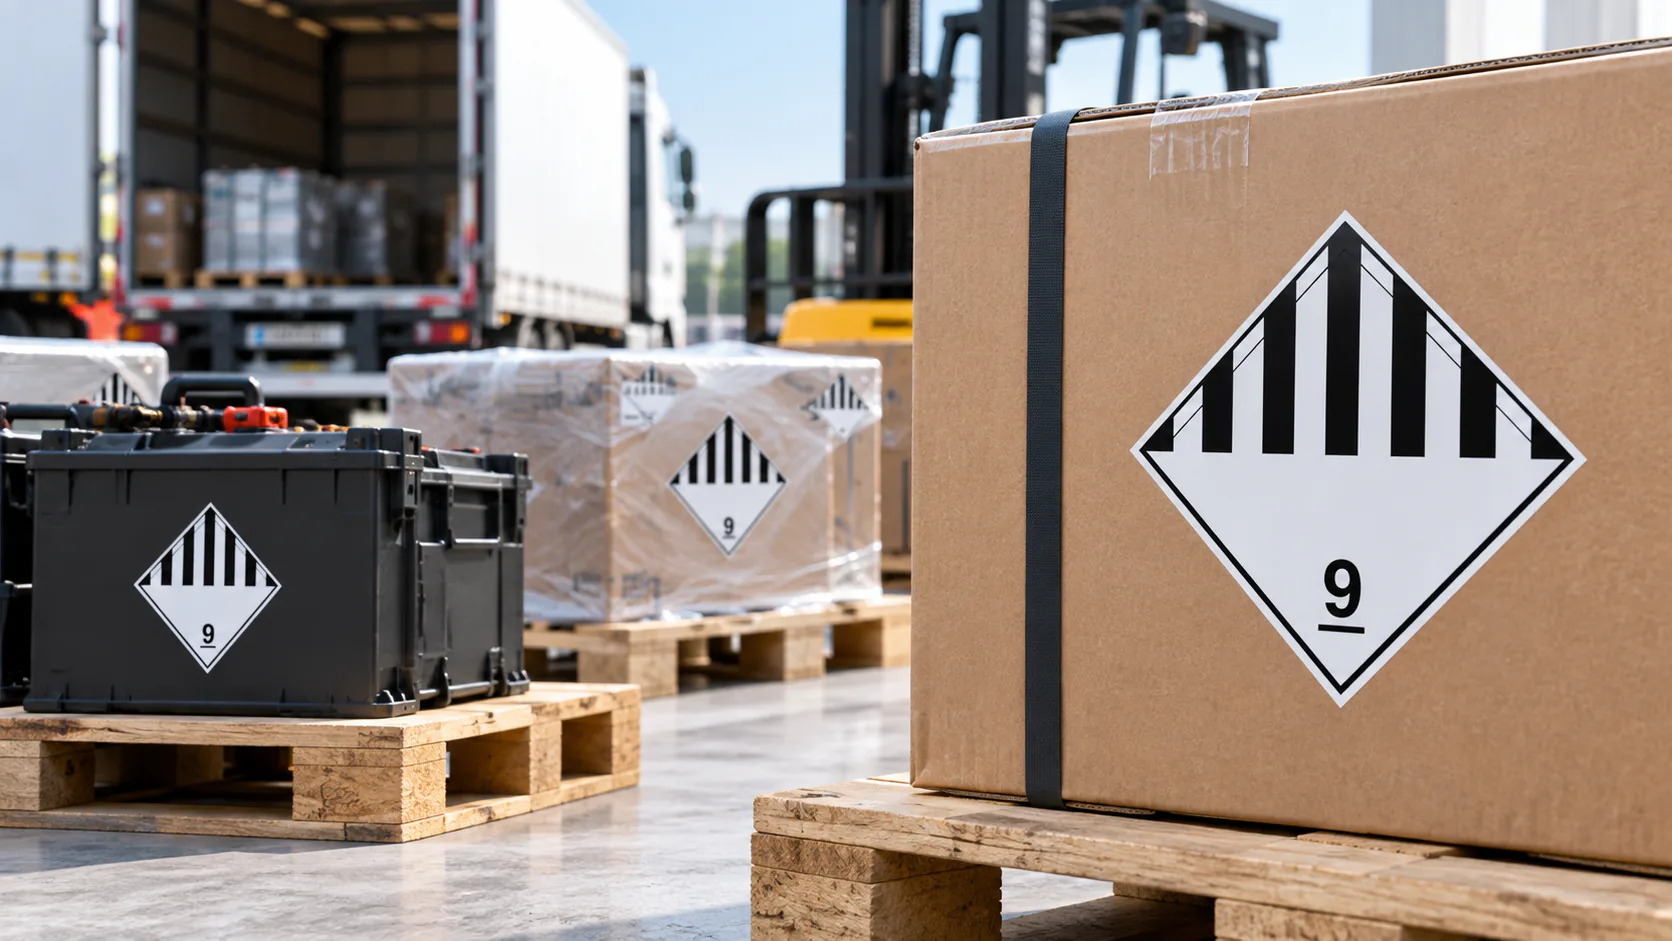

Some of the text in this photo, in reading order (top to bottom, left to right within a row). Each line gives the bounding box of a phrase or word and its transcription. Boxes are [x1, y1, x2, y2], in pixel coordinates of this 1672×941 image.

[723, 516, 735, 535] 9
[1324, 558, 1362, 619] 9
[202, 623, 215, 645] 9
